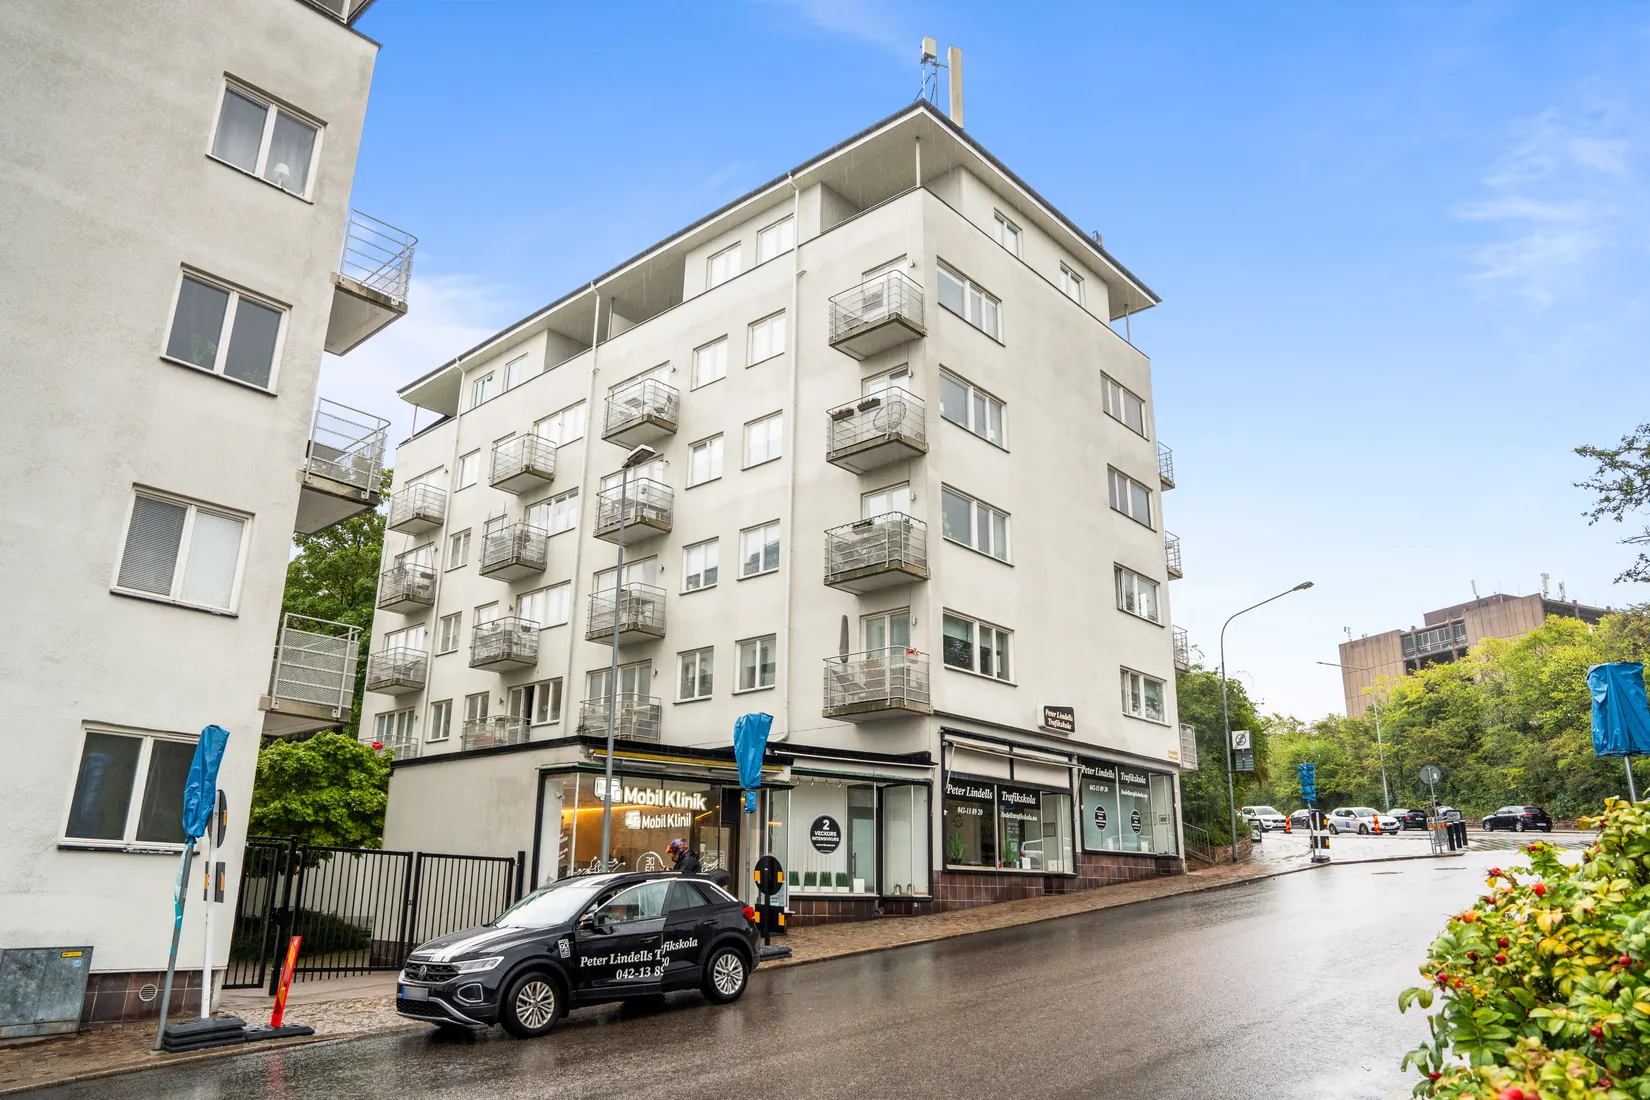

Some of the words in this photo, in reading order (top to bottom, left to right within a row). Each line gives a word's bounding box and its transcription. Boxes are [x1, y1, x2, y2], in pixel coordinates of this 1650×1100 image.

[1045, 709, 1056, 717] Peter
[1057, 712, 1073, 721] Lindells
[1048, 718, 1071, 729] Trafikskola
[1081, 765, 1095, 774] Peter
[1096, 768, 1114, 778] Lindells
[1121, 772, 1146, 784] Trafikskola
[623, 785, 664, 807] Mobil
[664, 789, 708, 812] Klinik
[946, 783, 966, 796] Peter
[966, 786, 993, 799] Lindells
[1001, 790, 1036, 805] Trafikskola
[957, 806, 972, 815] 042-13
[972, 807, 977, 815] 89
[977, 808, 983, 816] 20
[641, 815, 667, 830] Mobil
[822, 819, 830, 831] 2
[580, 955, 608, 968] Peter
[609, 950, 653, 966] Lindells
[654, 936, 698, 961] Tfikskola
[616, 966, 651, 980] 042-13
